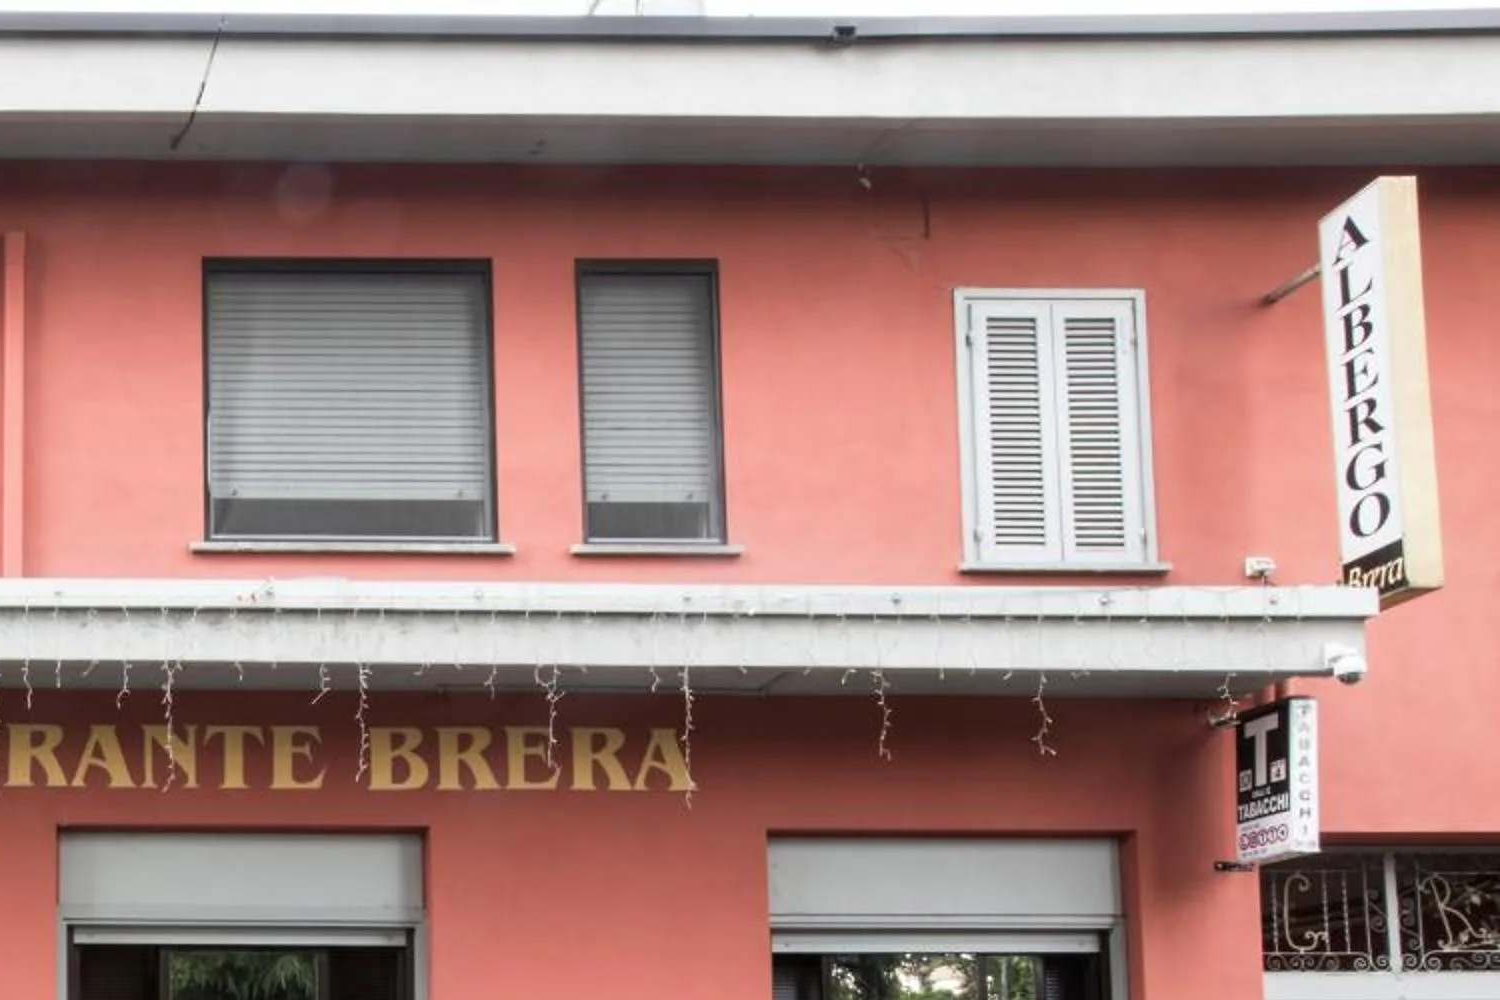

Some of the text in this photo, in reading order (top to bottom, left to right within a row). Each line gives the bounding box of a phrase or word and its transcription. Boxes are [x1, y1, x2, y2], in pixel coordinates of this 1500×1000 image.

[1332, 215, 1392, 538] ALBERGO
[367, 724, 698, 792] BRERA
[1243, 711, 1280, 788] T
[1237, 791, 1290, 821] TABACCHI
